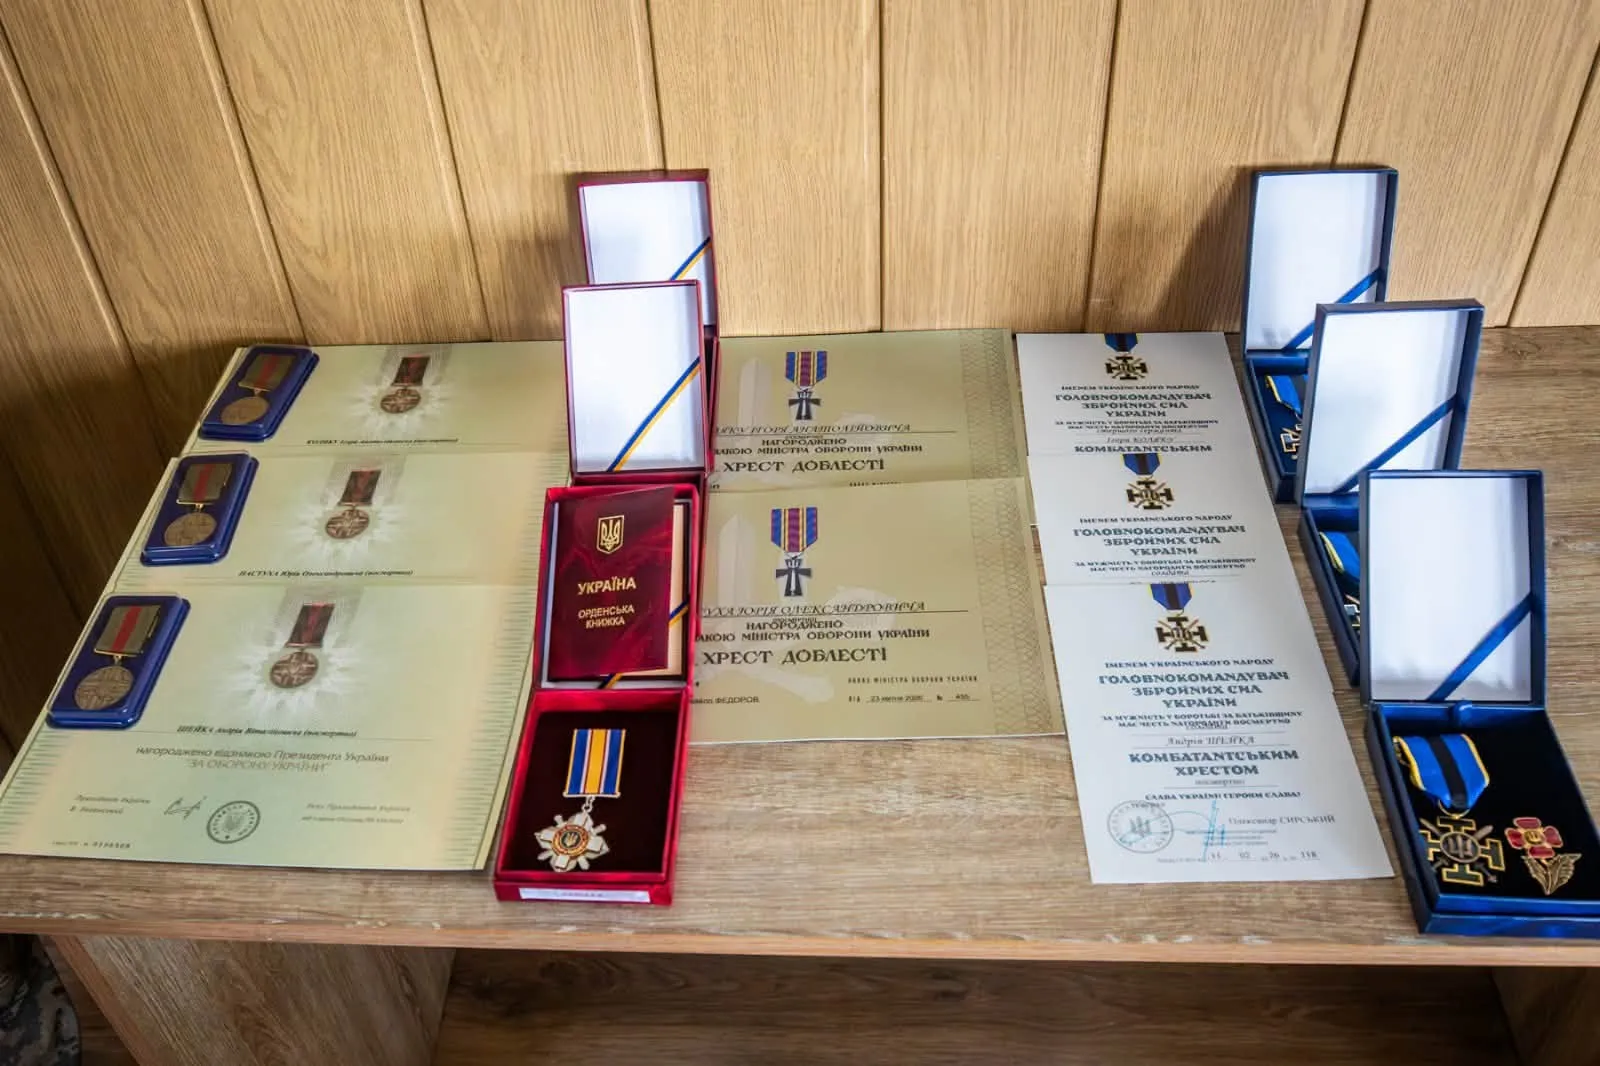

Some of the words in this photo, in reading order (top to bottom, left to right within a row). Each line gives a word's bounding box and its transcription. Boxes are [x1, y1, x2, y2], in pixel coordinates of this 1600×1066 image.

[1055, 393, 1212, 401] ГОЛОВНОКОМАНДУВАЧ
[762, 438, 847, 446] НАГОРОДЖЕНО
[757, 446, 809, 454] МІНІСТРА
[814, 445, 872, 454] ОБОРОНИ
[876, 444, 923, 454] УКРАЇНИ
[723, 461, 785, 472] ХРЕСТ
[792, 458, 885, 473] ДОБЛЕСТІ
[1073, 525, 1246, 536] ГОЛОВНОКОМАНДУВАЧ
[1103, 537, 1187, 546] ЗБРОЙНИХ
[1189, 536, 1221, 544] СИЛ
[1130, 547, 1197, 556] УКРАЇНИ
[578, 576, 636, 595] УКРАЇНА
[578, 604, 635, 620] ОРДЕНСЬКА
[586, 617, 625, 629] КНИЖКА
[746, 620, 843, 630] НАГОРОДЖЕНО
[742, 632, 801, 641] МІНІСТРА
[807, 630, 872, 640] ОБОРОНИ
[878, 628, 931, 640] УКРАЇНИ
[703, 650, 774, 665] ХРЕСТ
[782, 646, 888, 665] ДОБЛЕСТІ
[1232, 658, 1274, 666] НАРОДУ
[1098, 671, 1290, 684] ГОЛОВНОКОМАНДУВАЧ
[1131, 685, 1225, 696] ЗБРОЙНИХ
[1227, 684, 1262, 694] СИЛ
[1162, 698, 1237, 708] УКРАЇНИ
[1128, 750, 1300, 763] КОМБАТАНТСЬКИМ
[1175, 765, 1259, 776] ХРЕСТОМ
